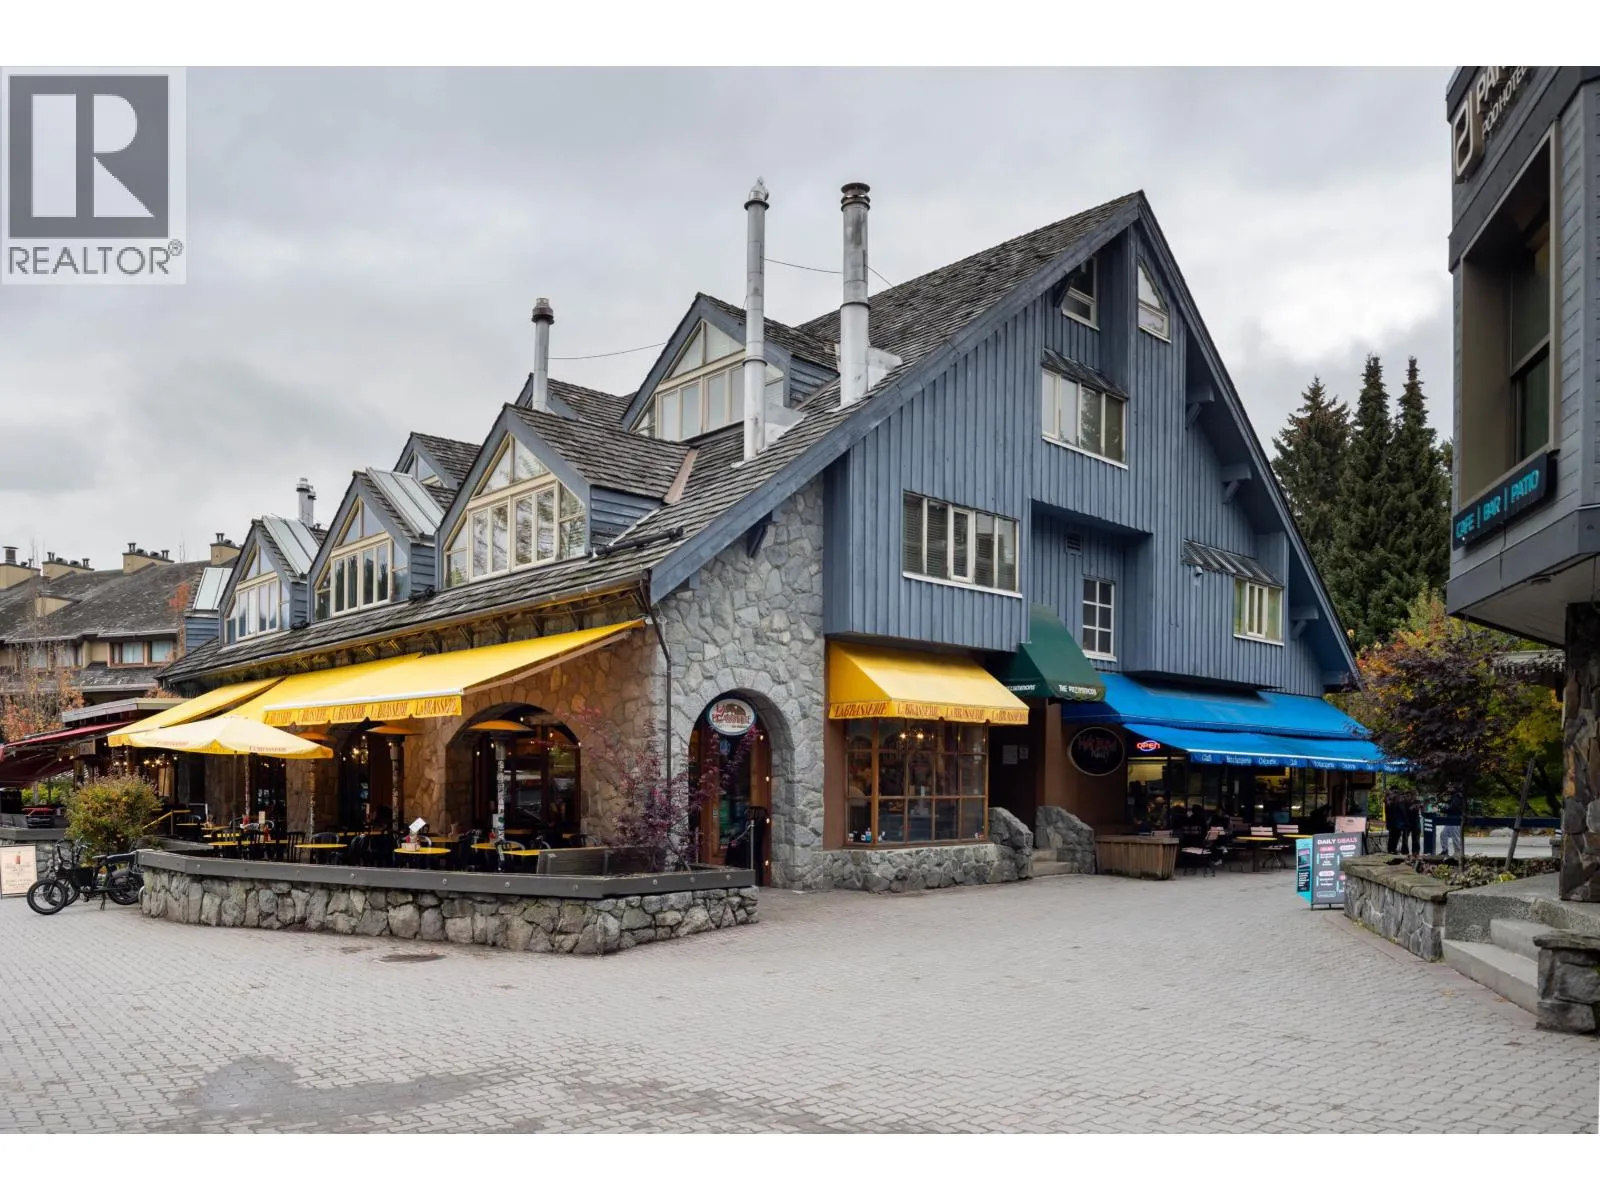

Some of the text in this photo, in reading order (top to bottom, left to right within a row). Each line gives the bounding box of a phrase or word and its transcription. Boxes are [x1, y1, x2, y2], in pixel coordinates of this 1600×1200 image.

[1482, 103, 1498, 140] POD
[1483, 496, 1501, 521] BAR
[1511, 470, 1540, 502] PATIO
[1136, 741, 1160, 750] OPEN
